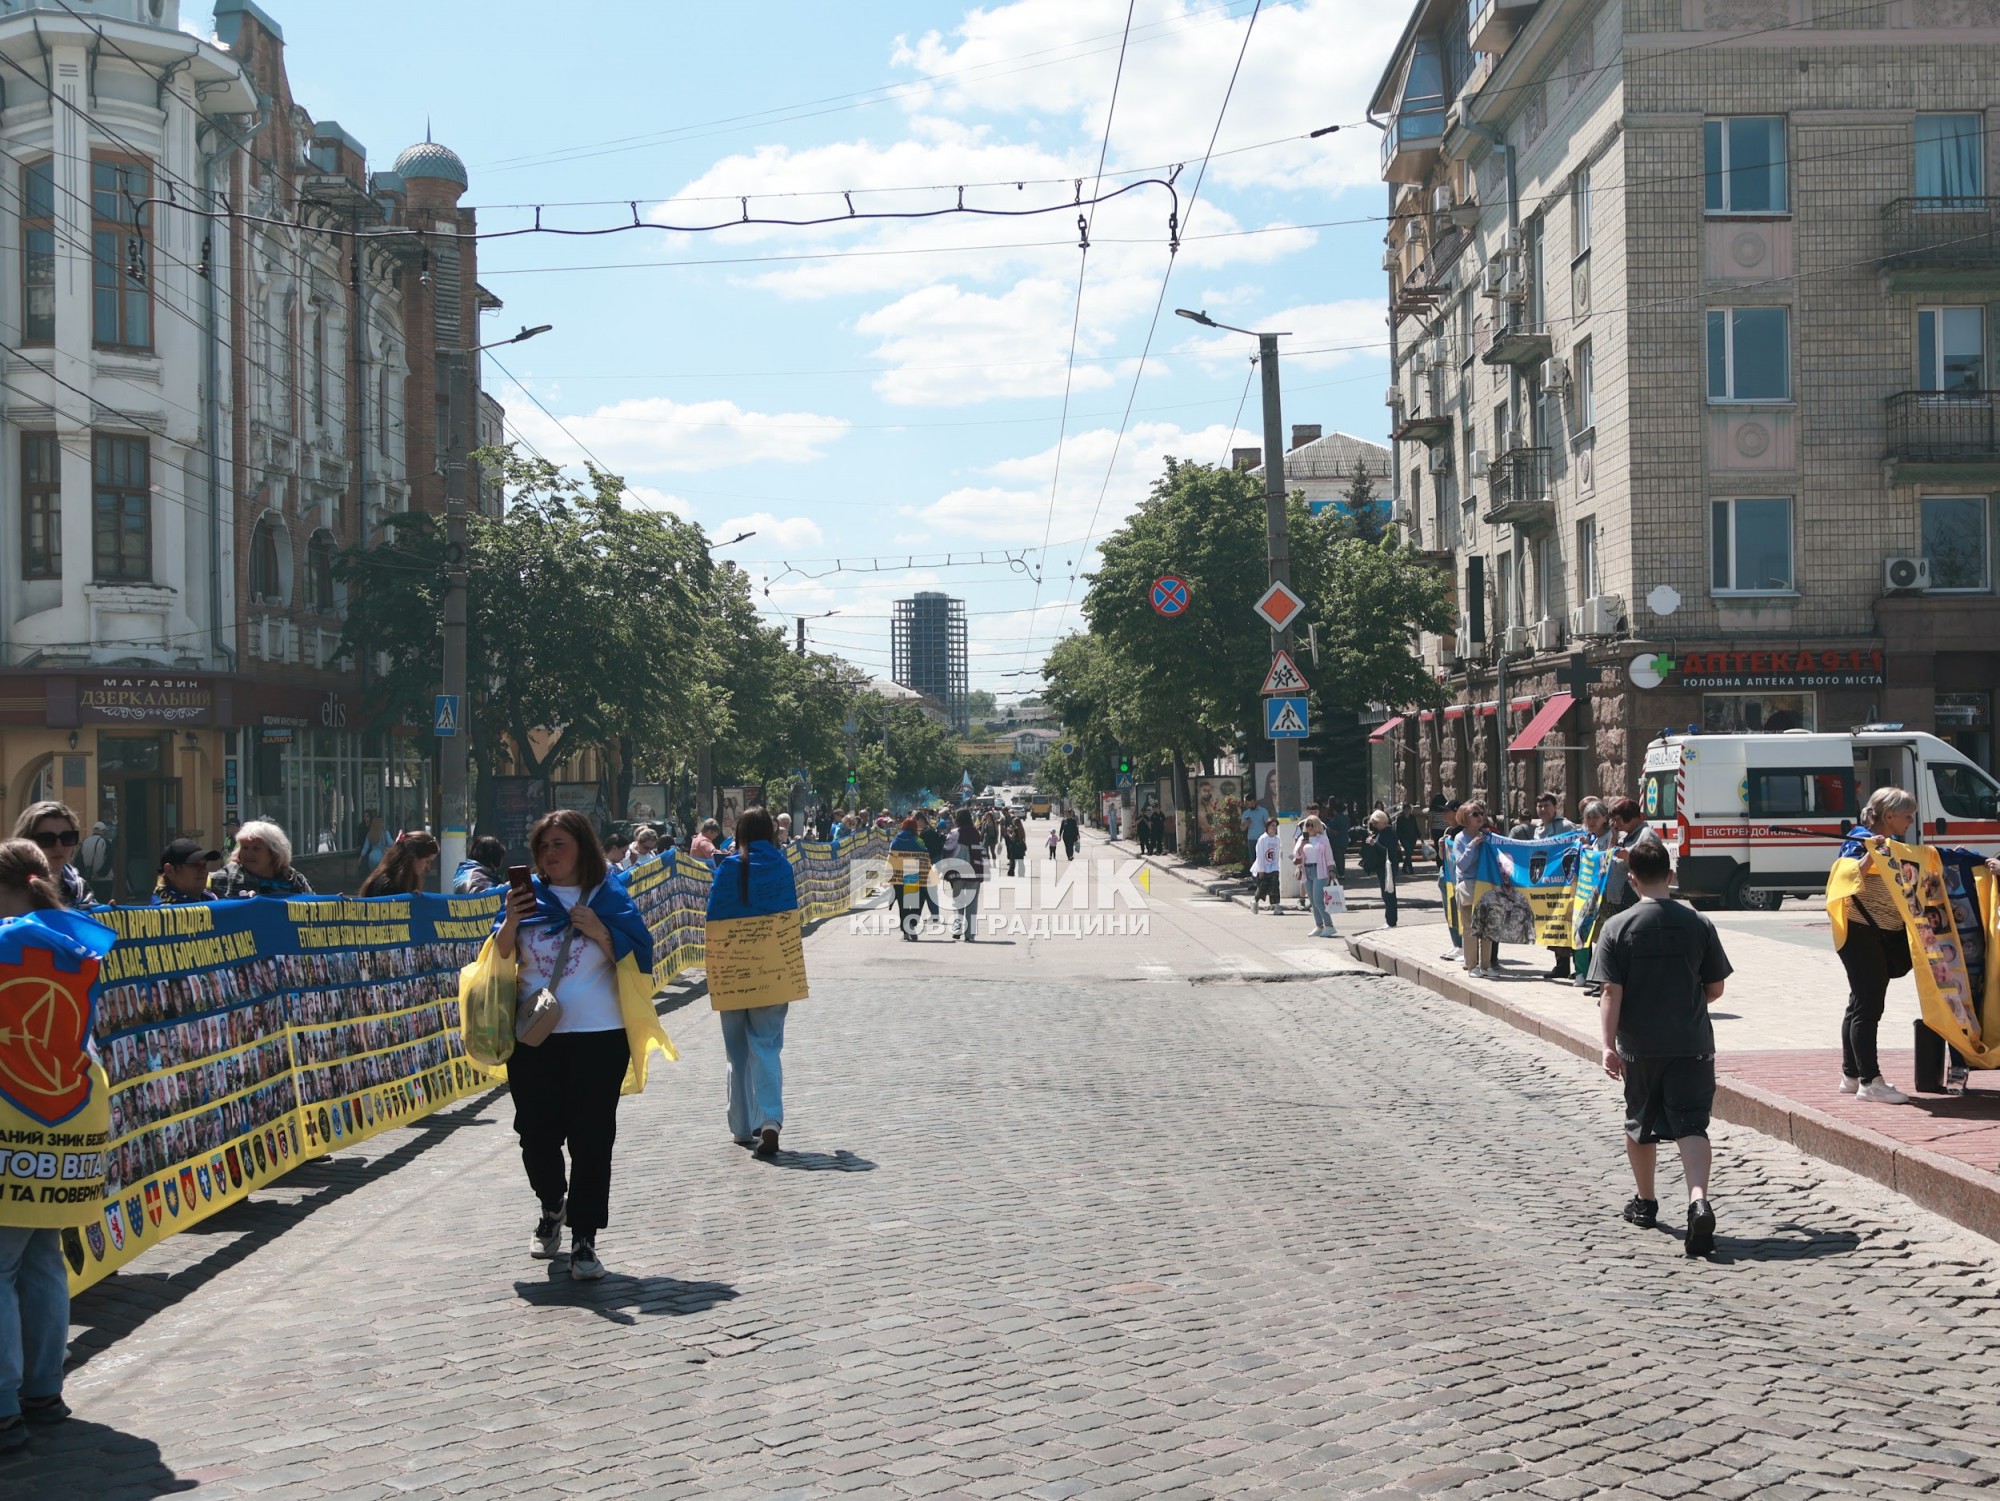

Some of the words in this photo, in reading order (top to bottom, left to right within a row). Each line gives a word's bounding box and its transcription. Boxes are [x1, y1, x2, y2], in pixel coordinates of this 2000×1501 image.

[1683, 651, 1817, 674] АПТЕКА
[103, 678, 198, 689] МАГАЗИН
[1683, 678, 1741, 687] ГОЛОВНА
[1746, 677, 1795, 687] АПТЕКА
[1800, 676, 1840, 686] ТВОГО
[1845, 675, 1883, 685] МІСТА
[80, 690, 212, 707] ДЗЕРКАЛЬНИЙ
[321, 690, 347, 728] elis
[1648, 751, 1680, 767] AMBULANCE
[127, 909, 161, 939] ВІРОЮ
[162, 908, 175, 935] ТА
[105, 949, 123, 982] ЗА
[145, 945, 161, 974] ЯК
[159, 944, 176, 971] ВИ
[173, 937, 225, 970] БОРОЛИСЯ
[222, 933, 238, 961] ЗА
[48, 1133, 84, 1146] ЗНИК
[10, 1184, 35, 1202] ТА
